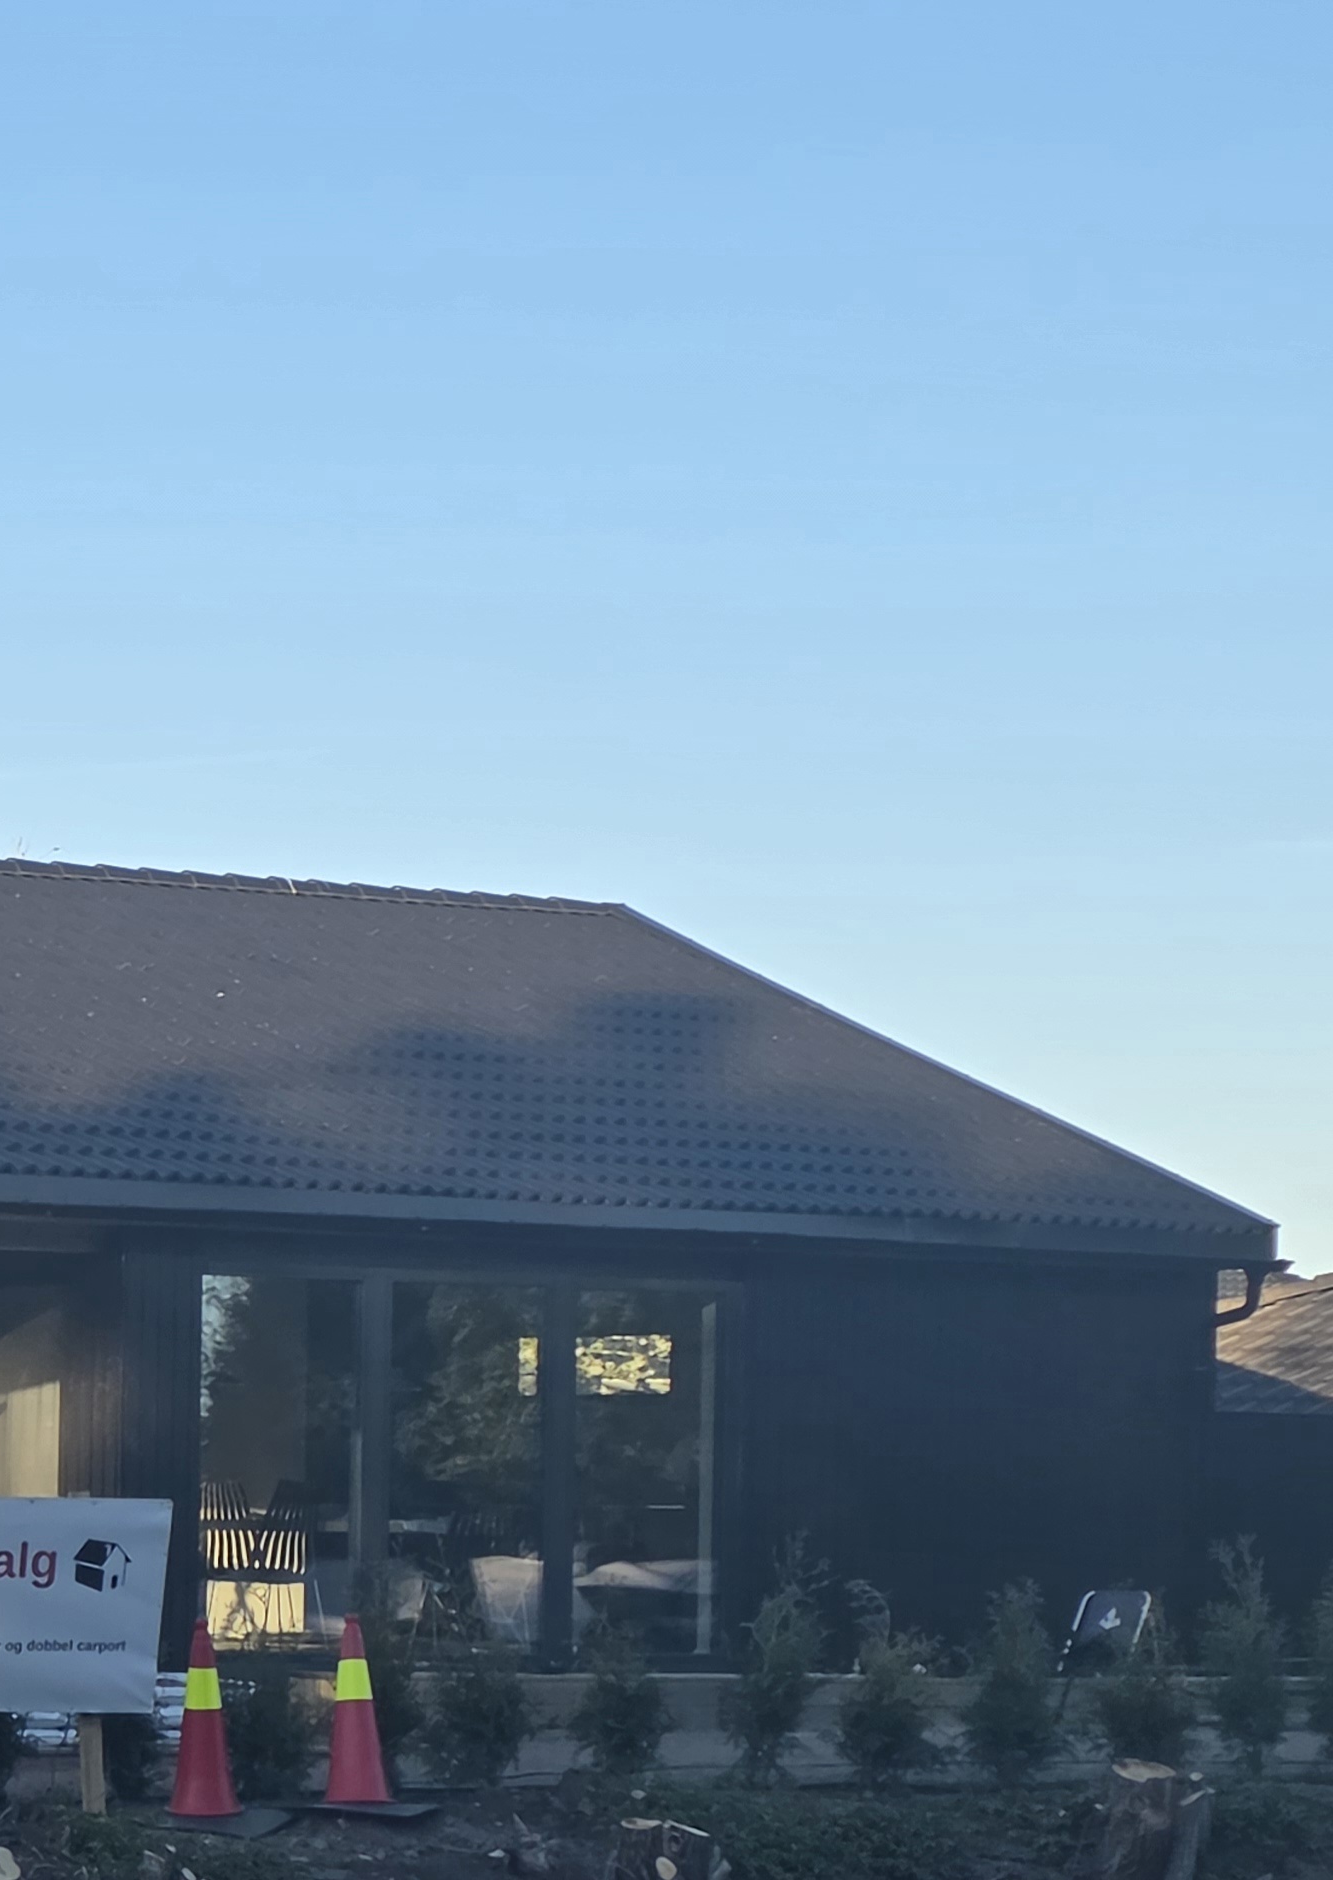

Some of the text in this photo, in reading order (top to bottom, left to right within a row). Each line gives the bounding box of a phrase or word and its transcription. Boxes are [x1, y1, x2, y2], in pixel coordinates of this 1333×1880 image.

[4, 1642, 22, 1655] og
[26, 1640, 73, 1652] dobbel
[77, 1640, 126, 1655] carport
